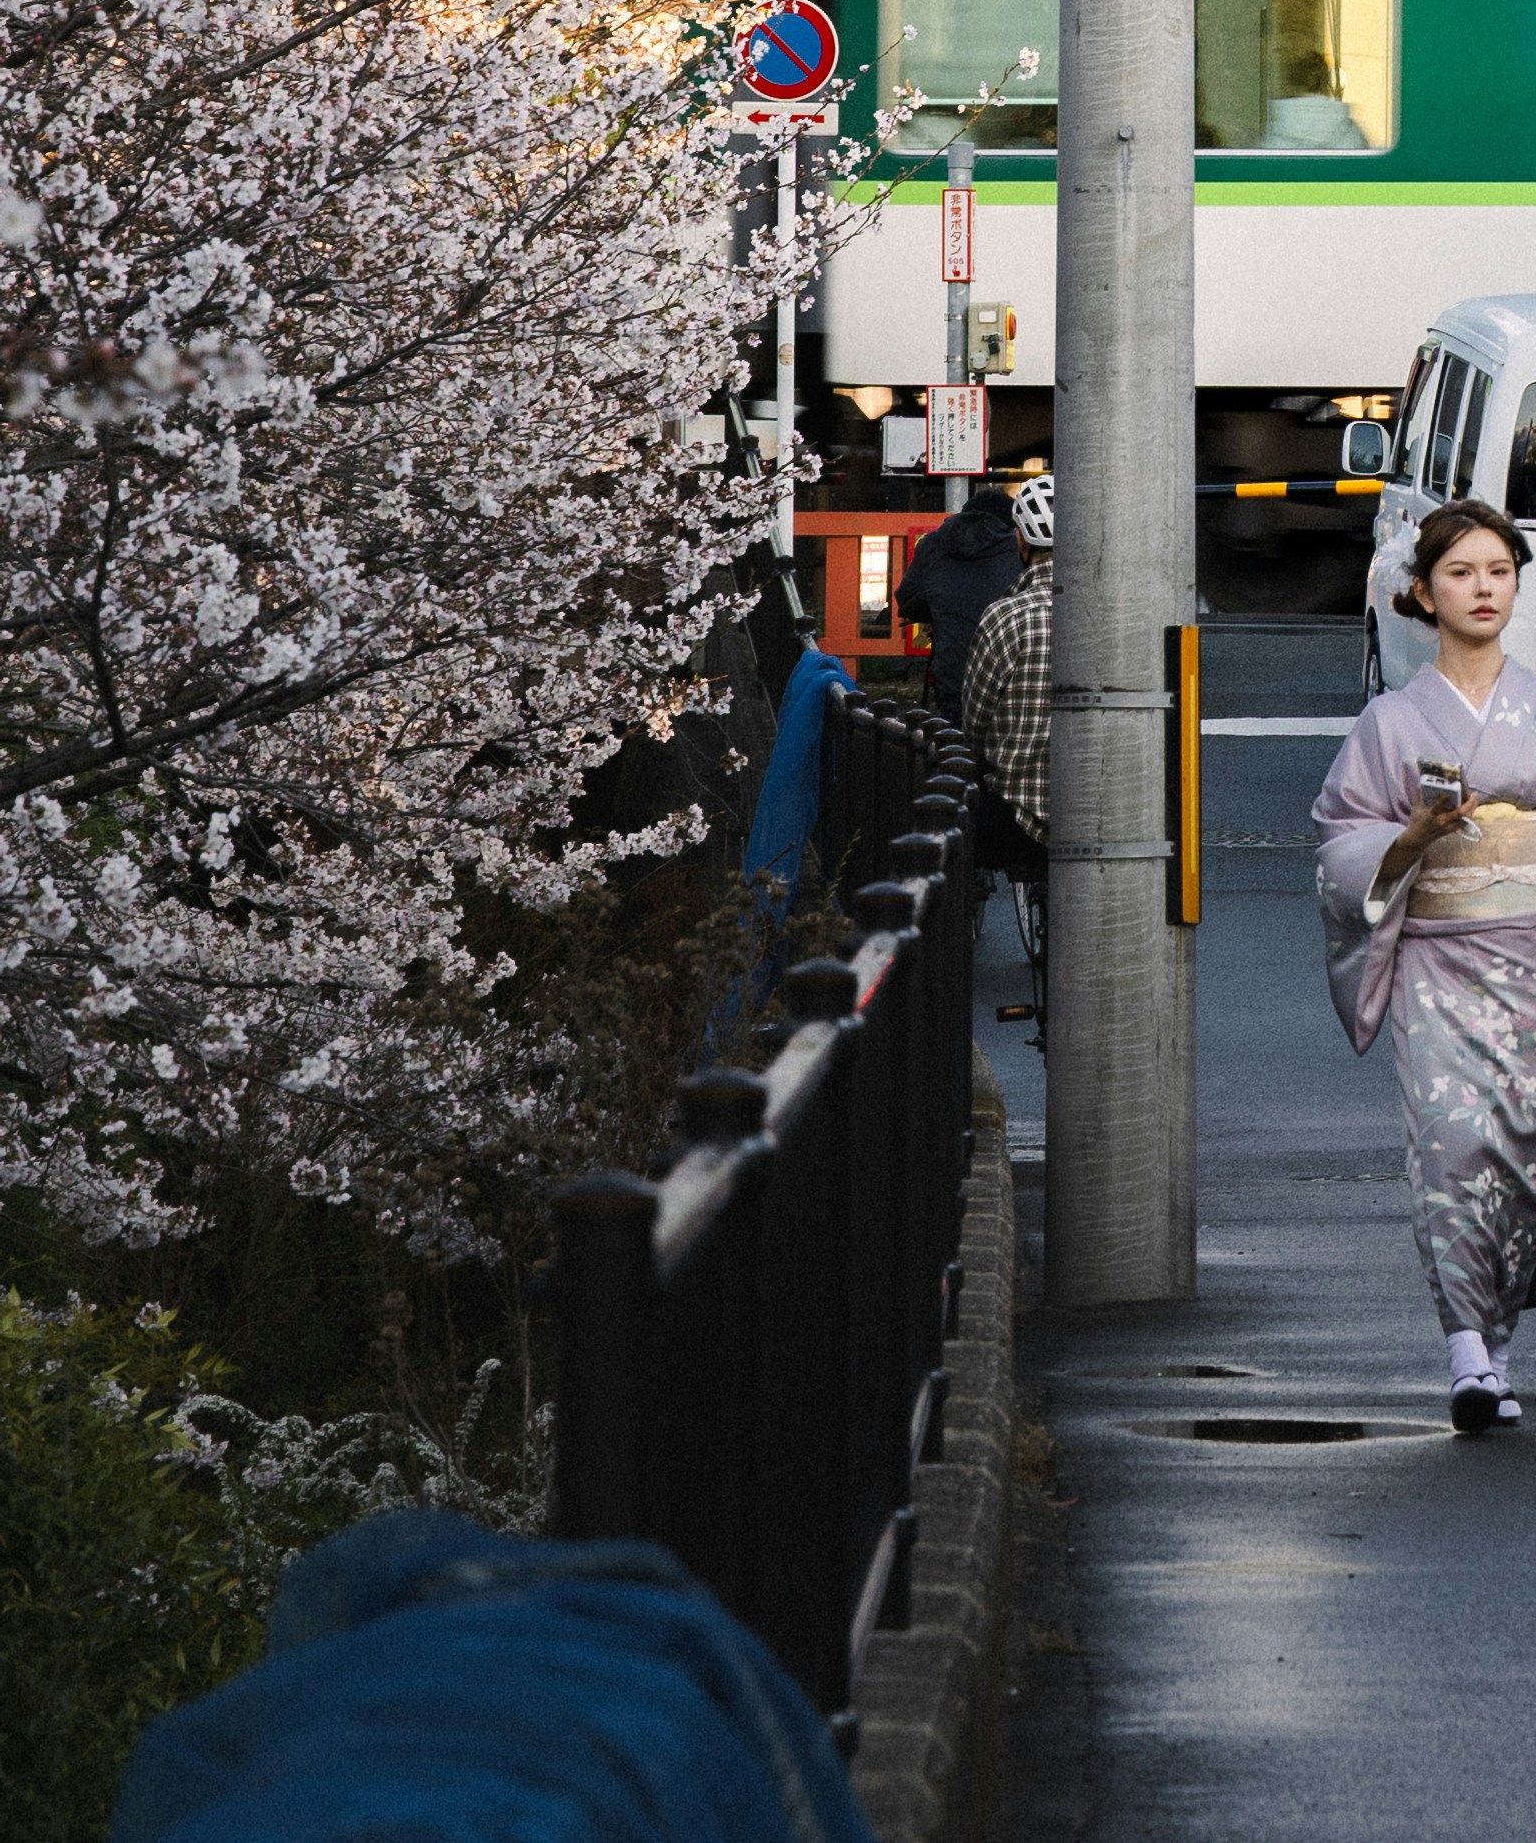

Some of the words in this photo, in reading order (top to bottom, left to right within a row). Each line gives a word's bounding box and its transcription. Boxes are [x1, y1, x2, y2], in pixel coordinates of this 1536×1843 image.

[950, 193, 962, 256] 非常ボタン
